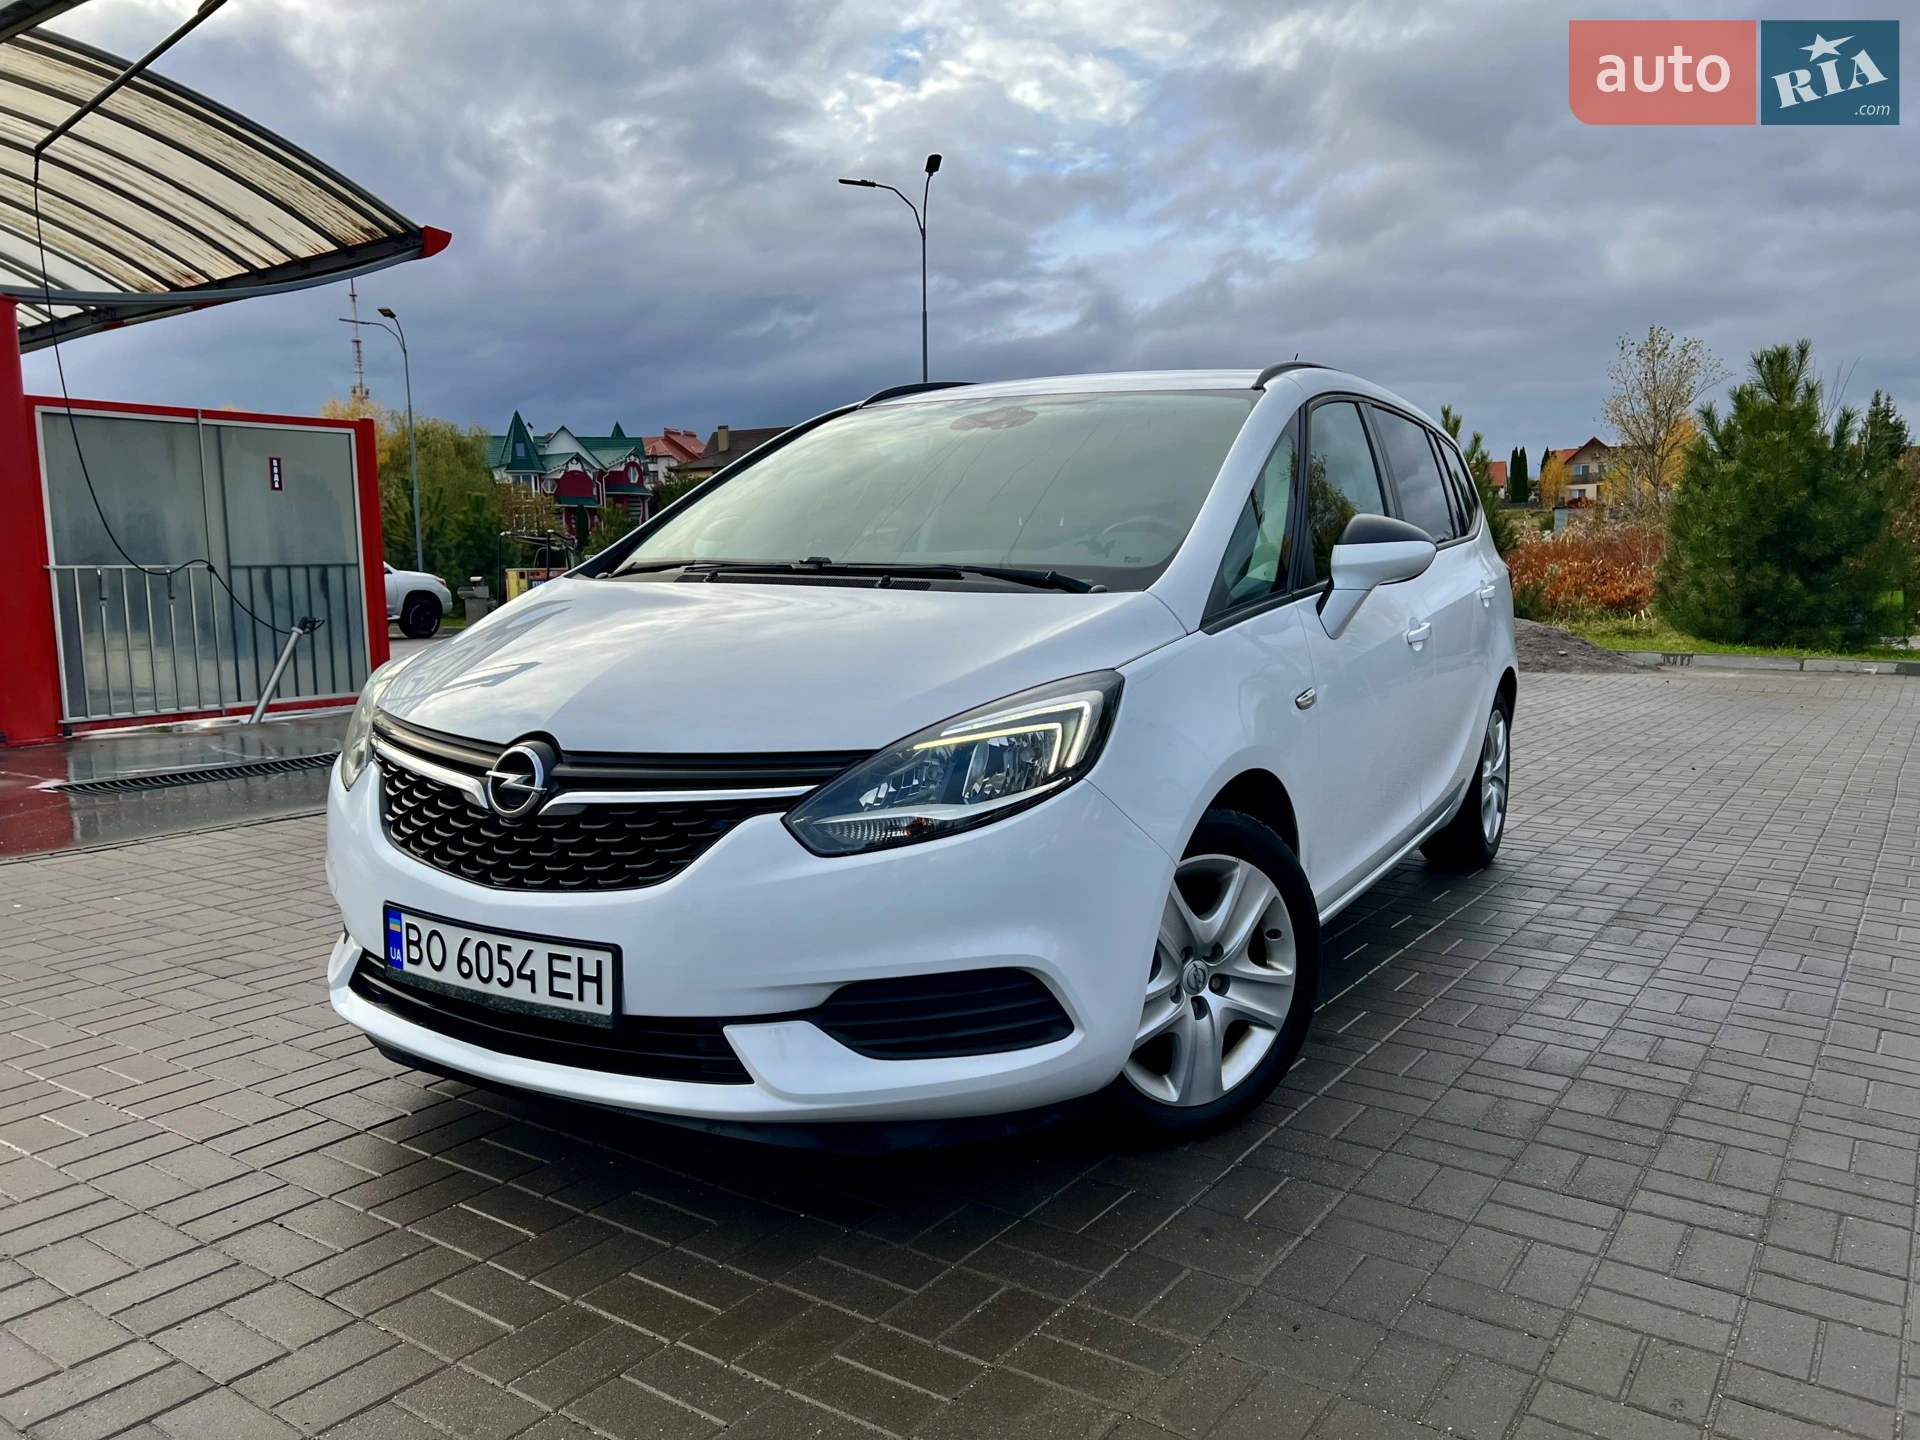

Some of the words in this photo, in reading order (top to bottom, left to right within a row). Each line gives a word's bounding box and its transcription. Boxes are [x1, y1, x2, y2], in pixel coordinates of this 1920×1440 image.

[389, 946, 403, 962] UA
[405, 921, 447, 973] BO
[457, 936, 537, 994] 6054
[547, 951, 604, 1006] EH
